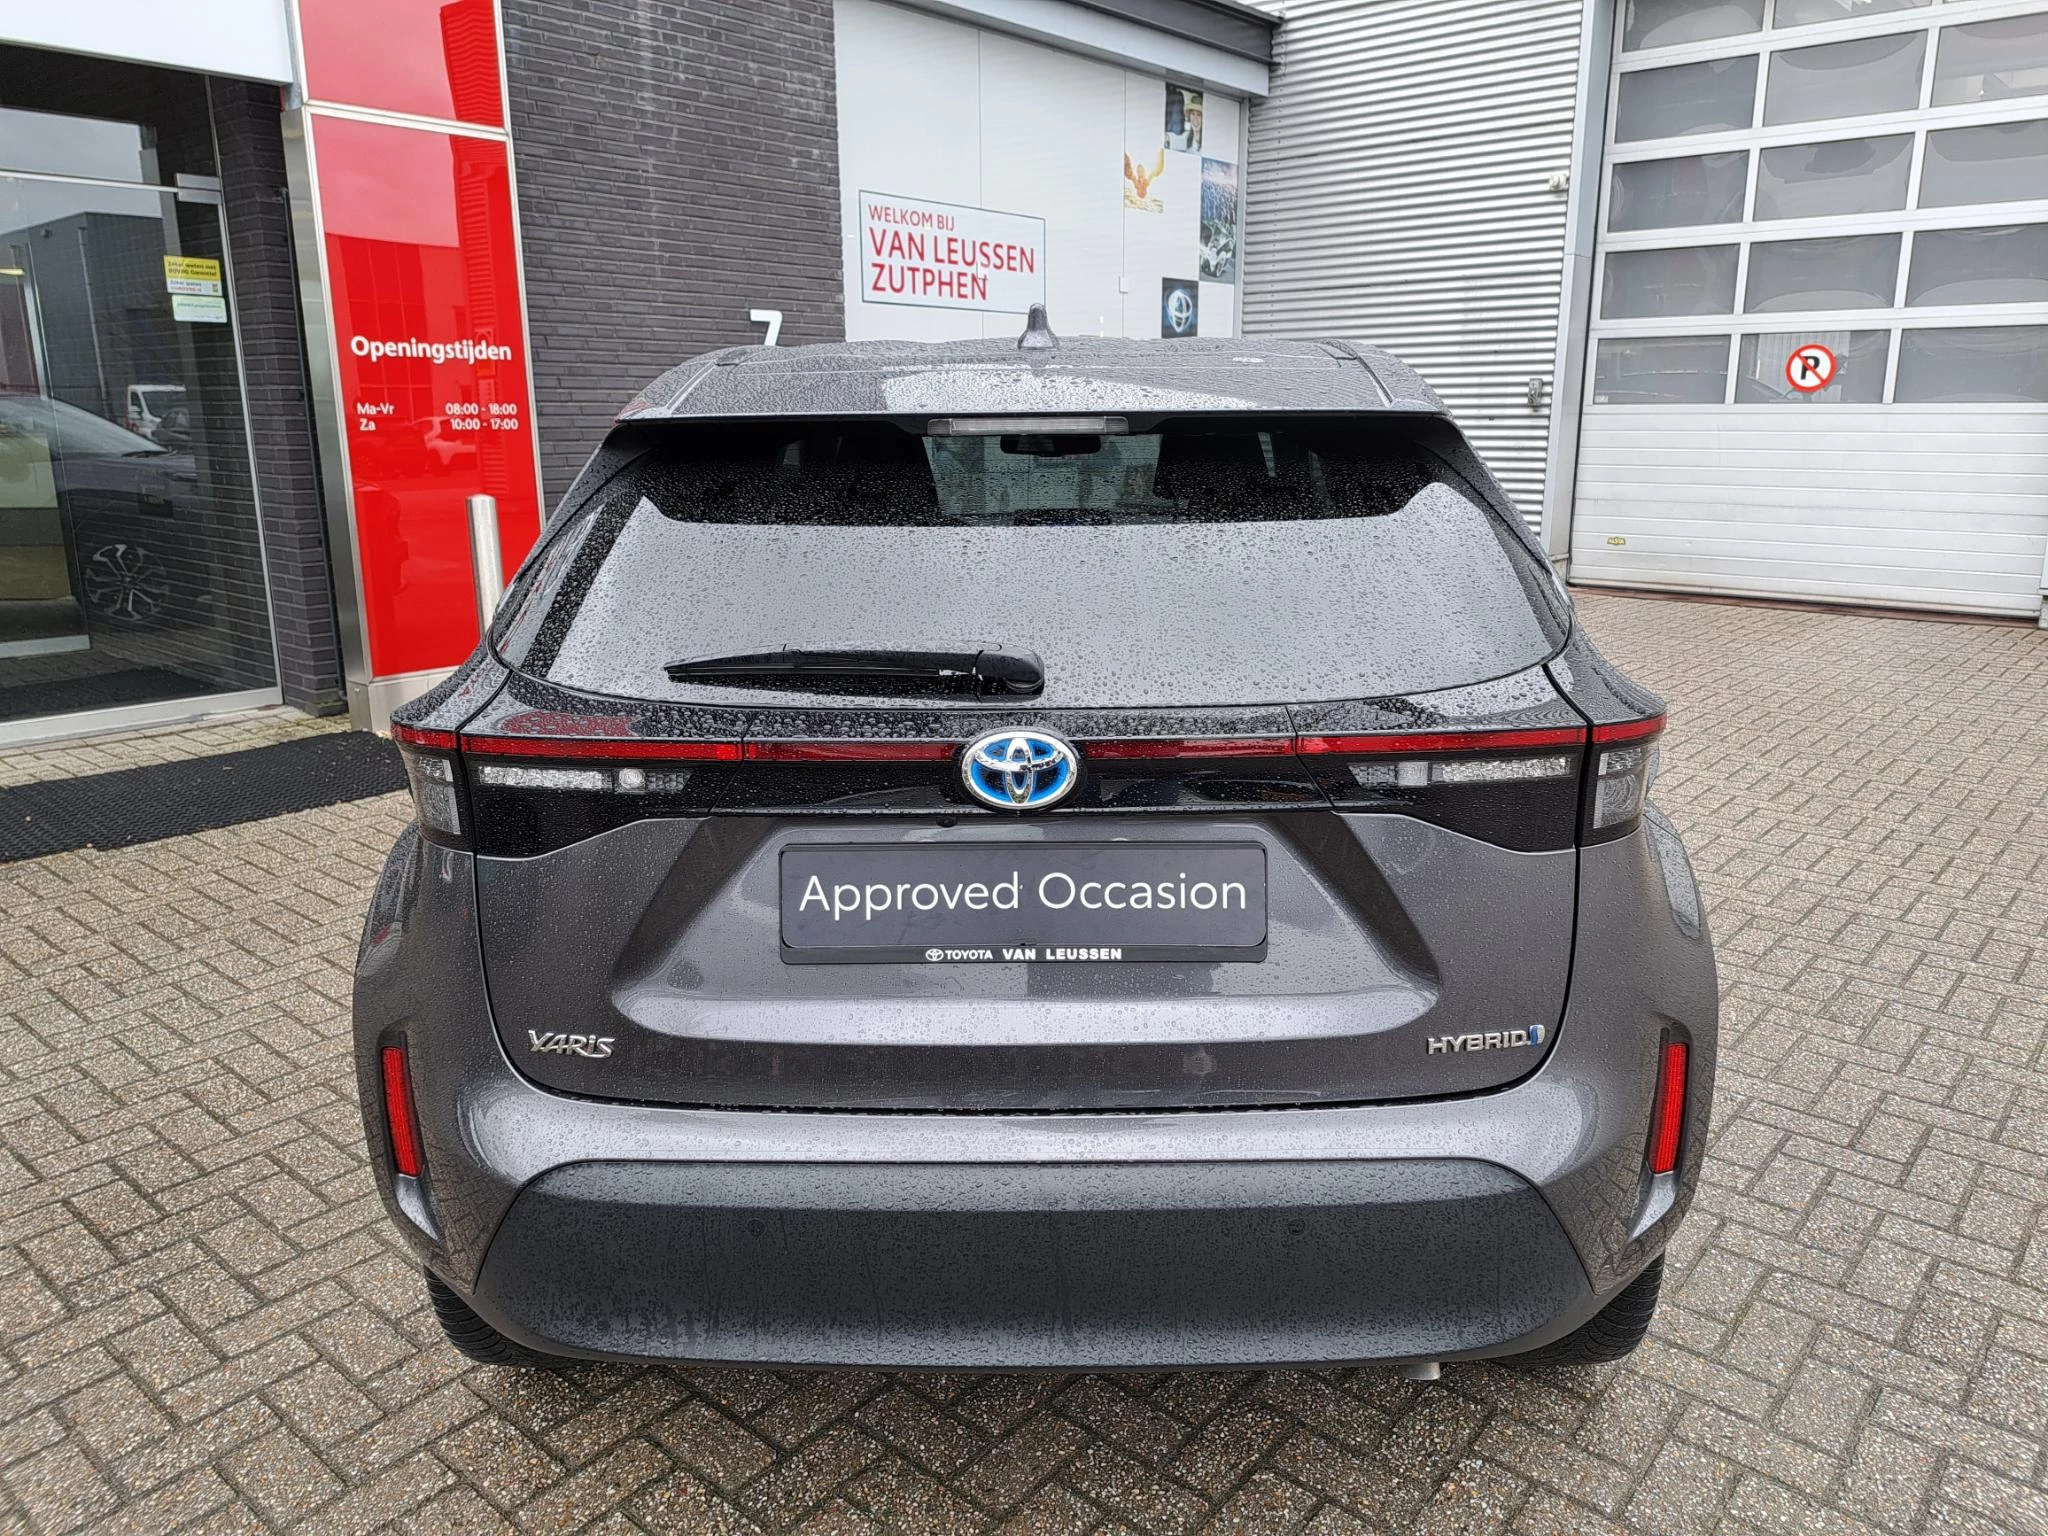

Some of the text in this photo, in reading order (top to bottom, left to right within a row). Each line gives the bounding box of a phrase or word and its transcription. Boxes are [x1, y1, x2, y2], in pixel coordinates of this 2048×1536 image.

[868, 204, 955, 231] WELKOM BIJ
[869, 226, 1035, 274] VAN LEUSSEN
[871, 262, 988, 300] ZUTPHEN
[750, 309, 783, 346] 7
[351, 335, 512, 365] Openingstijden
[1800, 355, 1820, 380] P
[356, 402, 395, 415] Ma-Vr
[445, 403, 479, 415] 08:00
[488, 403, 518, 415] 18:00
[360, 418, 376, 431] Za
[450, 418, 481, 430] 10:00
[490, 418, 519, 430] 17:00
[799, 871, 1246, 920] Approved Occasion
[945, 948, 1122, 960] TOYOTA VAN LEUSSEN
[1427, 1030, 1528, 1055] HYBRID
